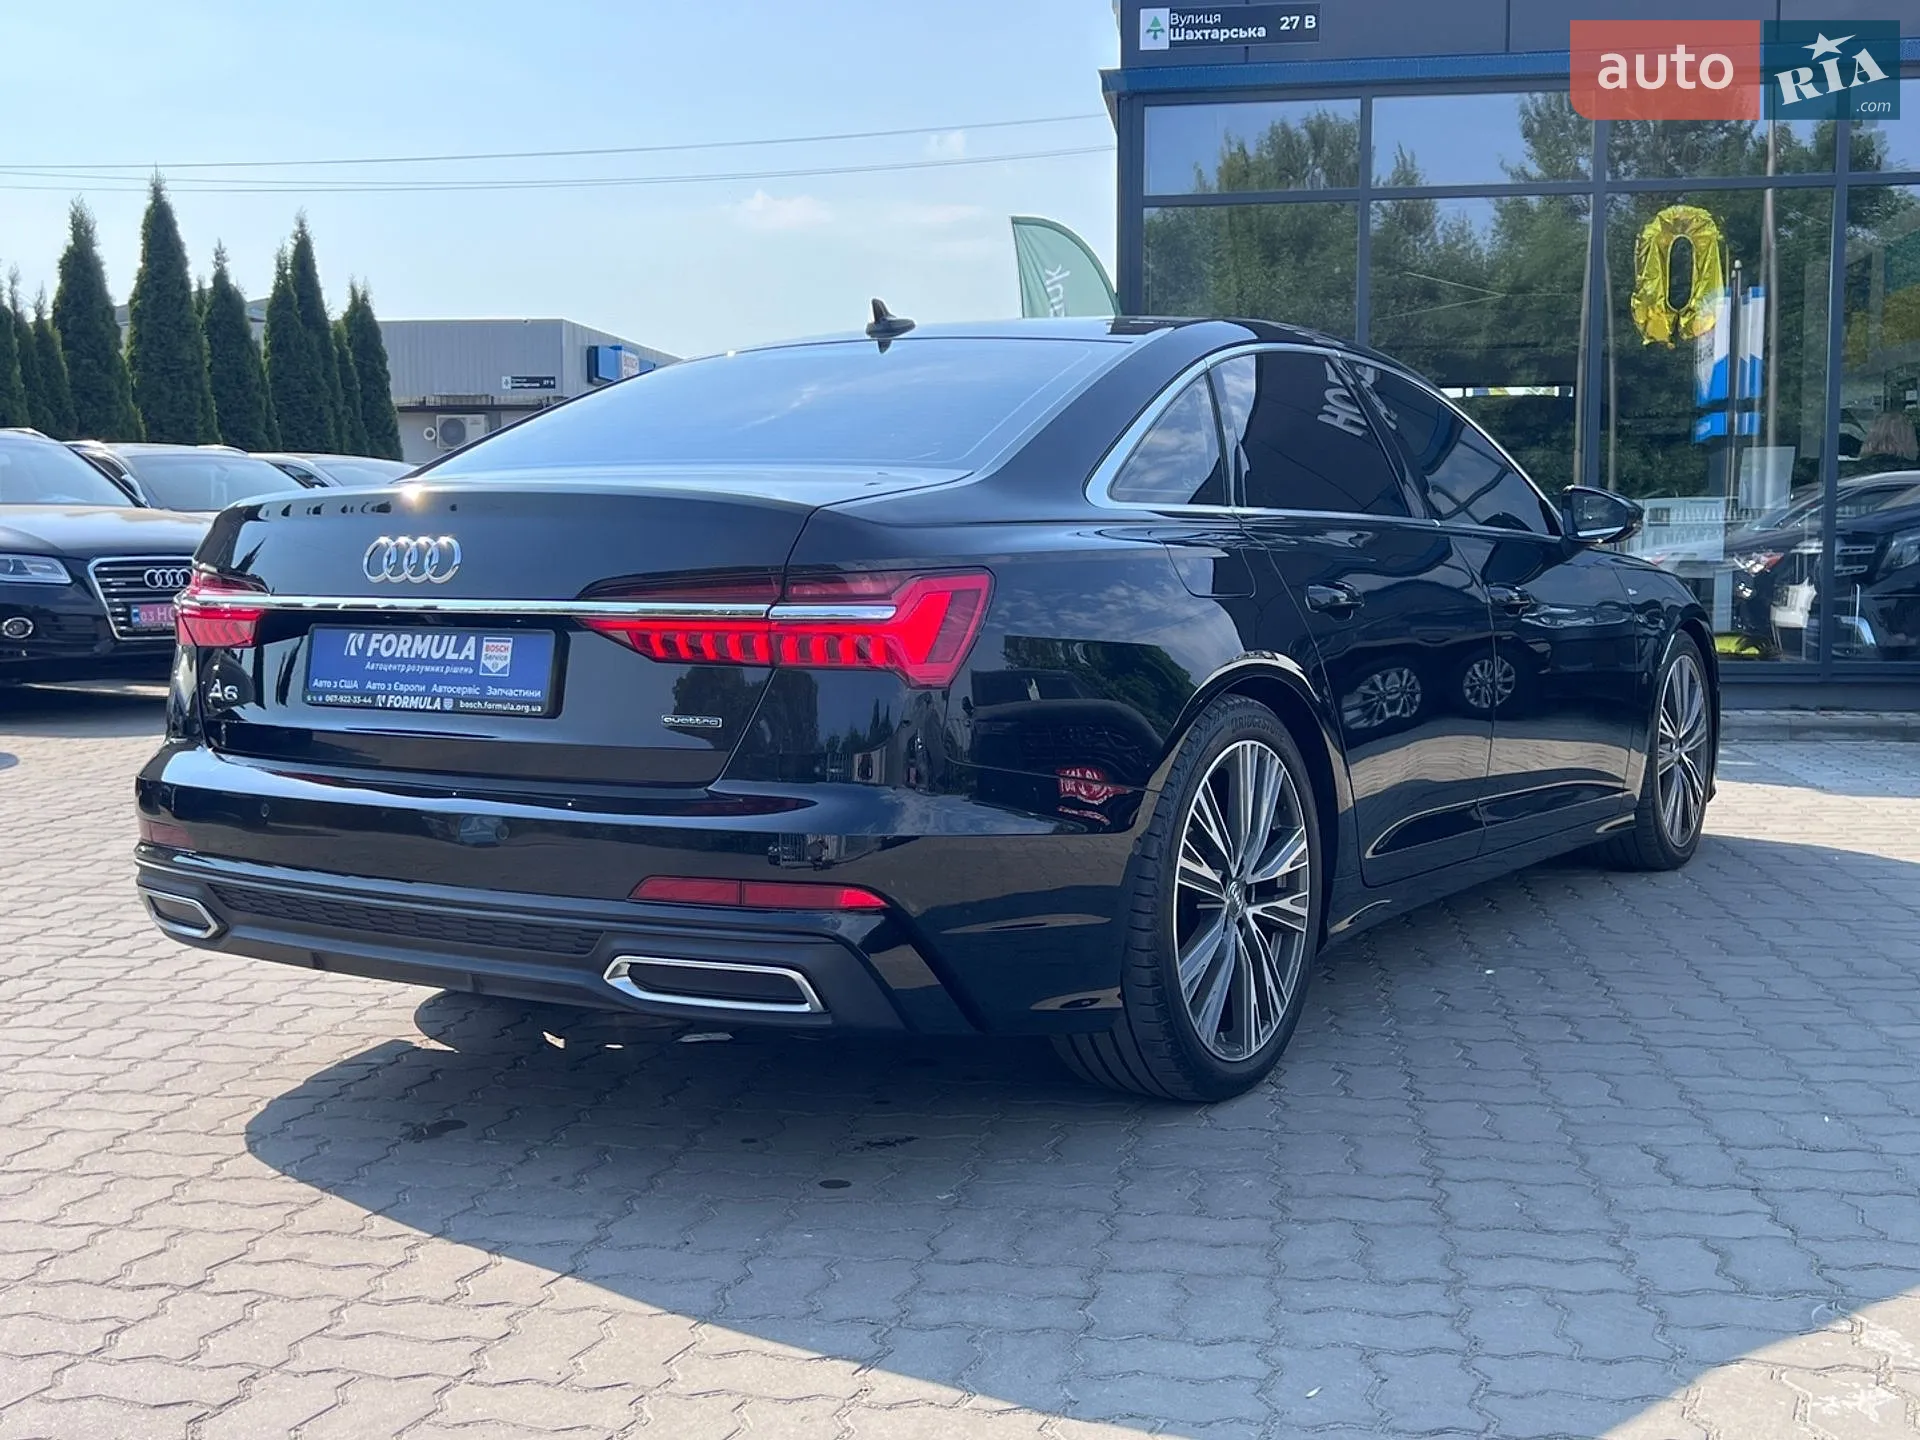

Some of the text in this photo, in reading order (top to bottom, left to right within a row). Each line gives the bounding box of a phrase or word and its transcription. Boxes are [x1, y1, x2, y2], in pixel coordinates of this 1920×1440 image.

[1170, 13, 1222, 27] Вулиця
[1279, 15, 1301, 30] 27
[1170, 26, 1267, 42] Шахтарська
[366, 633, 477, 661] FORMULA
[485, 644, 509, 653] BOSCH
[365, 661, 405, 673] Автоцентр
[208, 679, 239, 701] A6
[312, 678, 332, 688] Авто
[339, 679, 359, 689] США
[366, 680, 386, 690] Авто
[393, 681, 426, 693] Європи
[431, 683, 481, 697] Автосервіс
[486, 685, 542, 697] Запчастини
[386, 695, 441, 710] FORMULA
[459, 700, 542, 713] bosch.formula.org.ua
